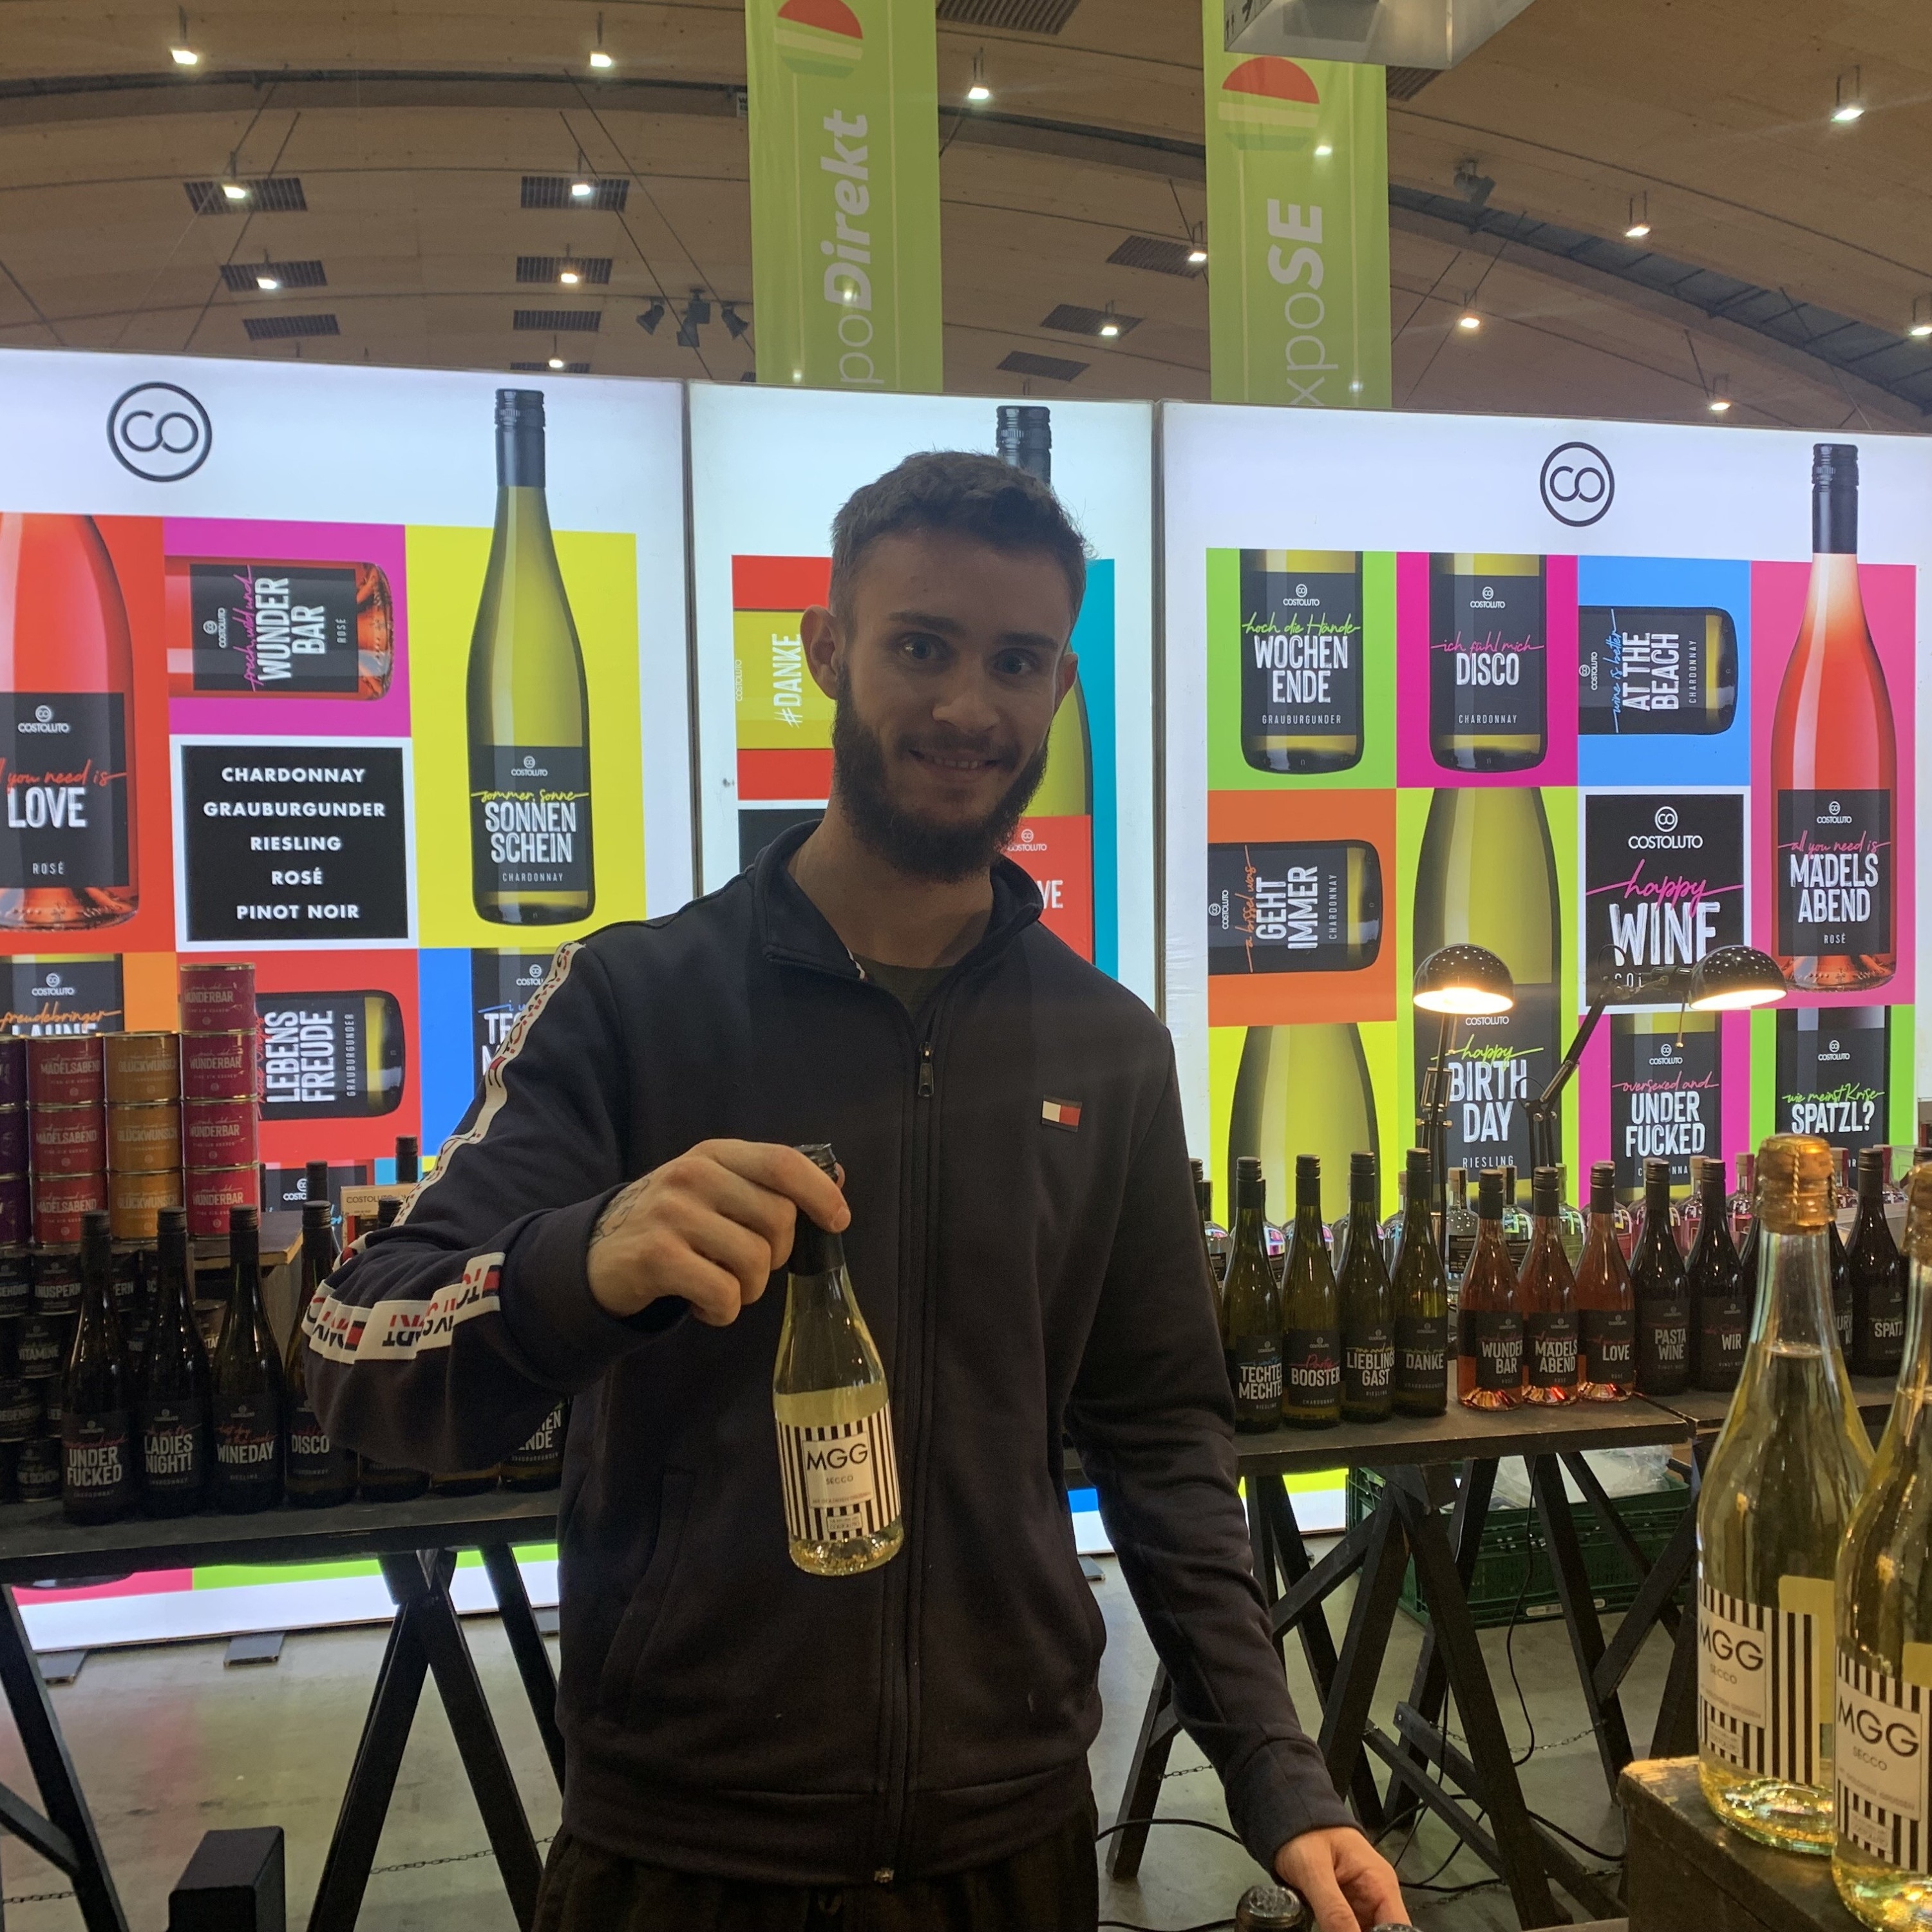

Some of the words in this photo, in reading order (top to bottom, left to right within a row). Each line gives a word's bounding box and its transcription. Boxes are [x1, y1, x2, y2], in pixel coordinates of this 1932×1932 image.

[820, 109, 884, 384] poDirekt
[1267, 198, 1338, 406] xpoSE
[233, 565, 253, 609] und
[1283, 598, 1320, 607] COSTOLUTO
[1470, 600, 1506, 609] COSTOLUTO
[218, 607, 226, 649] COSTOLUTO
[232, 607, 255, 638] wild
[254, 578, 291, 680] WUNDER
[291, 605, 325, 654] BAR
[336, 618, 346, 644] ROSÉ
[1242, 611, 1281, 634] hoch
[1283, 612, 1304, 635] die
[1254, 634, 1348, 669] WOCHEN
[1435, 630, 1466, 652] ich
[1501, 634, 1539, 652] mich
[1602, 621, 1622, 665] better
[1622, 632, 1651, 677] THE
[772, 633, 803, 728] #DANKE
[1456, 652, 1519, 686] DISCO
[1610, 667, 1623, 679] is
[1651, 634, 1680, 710] BEACH
[1689, 641, 1697, 704] CHARDONNAY
[1273, 670, 1331, 703] ENDE
[1622, 682, 1651, 711] AT
[1611, 683, 1621, 719] wine
[18, 723, 70, 733] COSTOLUTO
[1262, 714, 1341, 724] GRAUBURGUNDER
[1459, 714, 1517, 724] CHARDONNAY
[6, 773, 40, 795] you
[44, 758, 92, 785] need
[93, 770, 118, 787] is
[222, 768, 365, 784] CHARDONNAY
[7, 786, 86, 828] LOVE
[203, 802, 386, 818] GRAUBURGUNDER
[485, 802, 576, 832] SONNEN
[250, 837, 341, 851] RIESLING
[491, 833, 572, 863] SCHEIN
[1628, 835, 1703, 849] COSTOLUTO
[1786, 829, 1808, 851] all
[1808, 842, 1831, 861] you
[1833, 830, 1866, 853] need
[1868, 839, 1884, 853] is
[33, 862, 64, 875] ROSÉ
[271, 869, 323, 885] ROSÉ
[502, 873, 563, 882] CHARDONNAY
[1790, 853, 1879, 887] MÄDELS
[1604, 858, 1727, 918] happy
[236, 904, 298, 921] PINOT
[307, 904, 359, 920] NOIR
[1256, 876, 1287, 940] GEHT
[1287, 866, 1318, 949] IMMER
[1329, 875, 1337, 940] CHARDONNAY
[1798, 887, 1871, 923] ABEND
[1824, 933, 1846, 944] ROSÉ
[31, 987, 75, 996] COSTOLUTO
[184, 991, 234, 1003] WUNDERBAR
[1465, 1016, 1510, 1025] COSTOLUTO
[190, 1056, 242, 1069] WUNDERBAR
[264, 1011, 300, 1103] LEBENS
[299, 1010, 335, 1102] FREUDE
[345, 1014, 355, 1097] GRAUBURGUNDER
[1449, 1034, 1526, 1071] happy
[1818, 1052, 1850, 1061] COSTOLUTO
[1448, 1059, 1527, 1102] BIRTH
[1618, 1070, 1682, 1093] oversexed
[1683, 1071, 1715, 1089] and
[1631, 1091, 1700, 1125] UNDER
[1792, 1101, 1875, 1133] SPATZL?
[189, 1124, 240, 1137] WUNDERBAR
[1463, 1101, 1513, 1143] DAY
[1626, 1122, 1705, 1157] FUCKED
[1463, 1155, 1513, 1168] RIESLING
[193, 1193, 243, 1205] WUNDERBAR
[1655, 1328, 1686, 1345] PASTA
[1721, 1333, 1742, 1350] WIR
[1406, 1353, 1444, 1370] DANKE
[1602, 1345, 1630, 1361] LOVE
[1658, 1344, 1685, 1361] WINE
[1240, 1363, 1282, 1383] TECHTE
[1291, 1364, 1340, 1387] BOOSTER
[1495, 1358, 1517, 1374] BAR
[1539, 1356, 1576, 1373] ABEND
[1239, 1379, 1282, 1399] MECHTE
[1362, 1368, 1390, 1387] GAST
[144, 1434, 193, 1455] LADIES
[216, 1441, 274, 1464] WINEDAY
[291, 1435, 330, 1454] DISCO
[518, 1431, 553, 1451] NDE
[70, 1446, 118, 1467] UNDER
[146, 1453, 192, 1474] NIGHT!
[807, 1443, 868, 1470] MGG
[67, 1464, 122, 1486] FUCKED
[1700, 1618, 1764, 1671] MGG
[1838, 1695, 1919, 1757] MGG
[1853, 1746, 1888, 1771] SECCO
